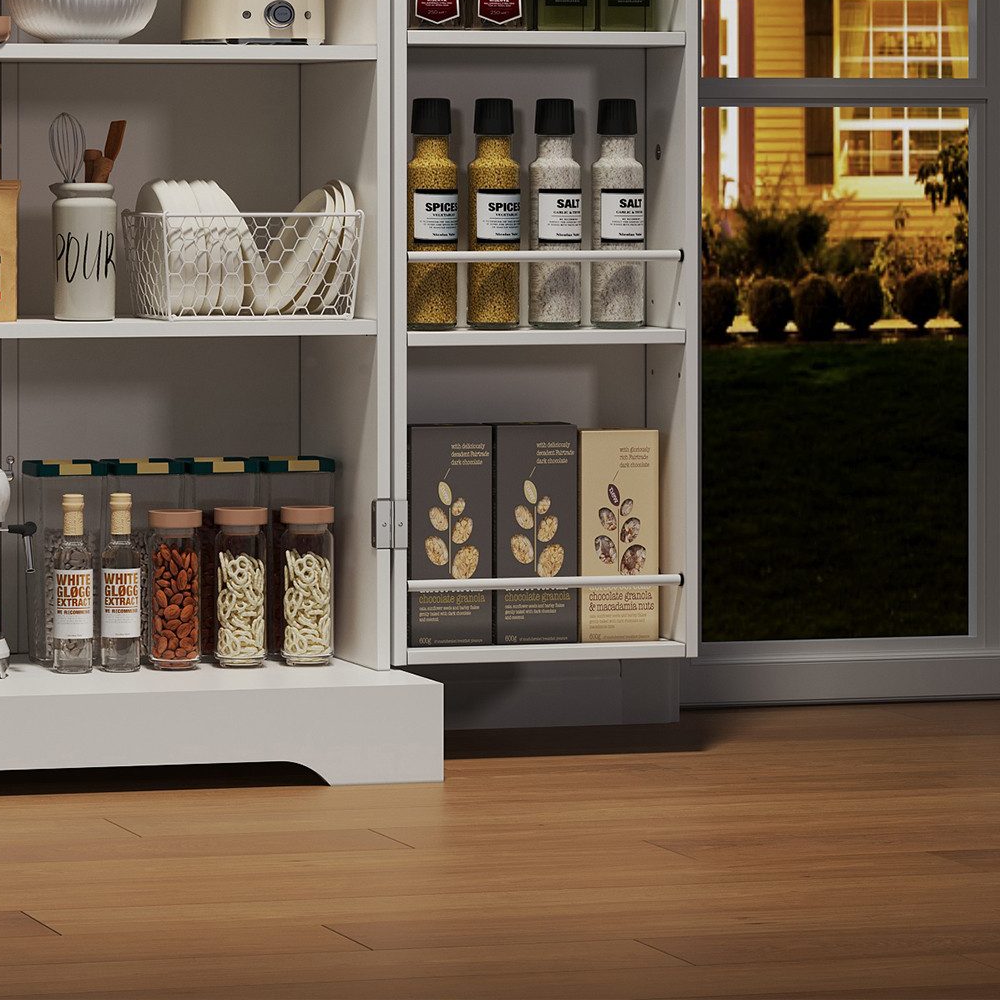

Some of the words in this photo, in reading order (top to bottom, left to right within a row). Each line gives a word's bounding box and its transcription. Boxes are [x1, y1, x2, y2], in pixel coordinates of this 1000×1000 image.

[425, 202, 458, 212] SPICES
[488, 202, 520, 212] SPICES
[556, 198, 580, 209] SALT
[619, 198, 643, 209] SALT
[56, 230, 116, 284] POUR
[56, 573, 91, 586] WHITE
[104, 572, 138, 585] WHITE
[56, 586, 91, 598] GLØGG
[104, 584, 139, 597] GLØGG
[588, 591, 623, 601] chocolate
[624, 590, 653, 602] granola
[56, 598, 91, 607] EXTRACT
[104, 597, 139, 606] EXTRACT
[418, 593, 455, 604] chocolate
[456, 593, 486, 605] granola
[504, 592, 541, 602] chocolate
[541, 591, 572, 603] granola
[588, 602, 596, 612] &
[596, 601, 638, 611] macadamia
[638, 602, 655, 611] nuts
